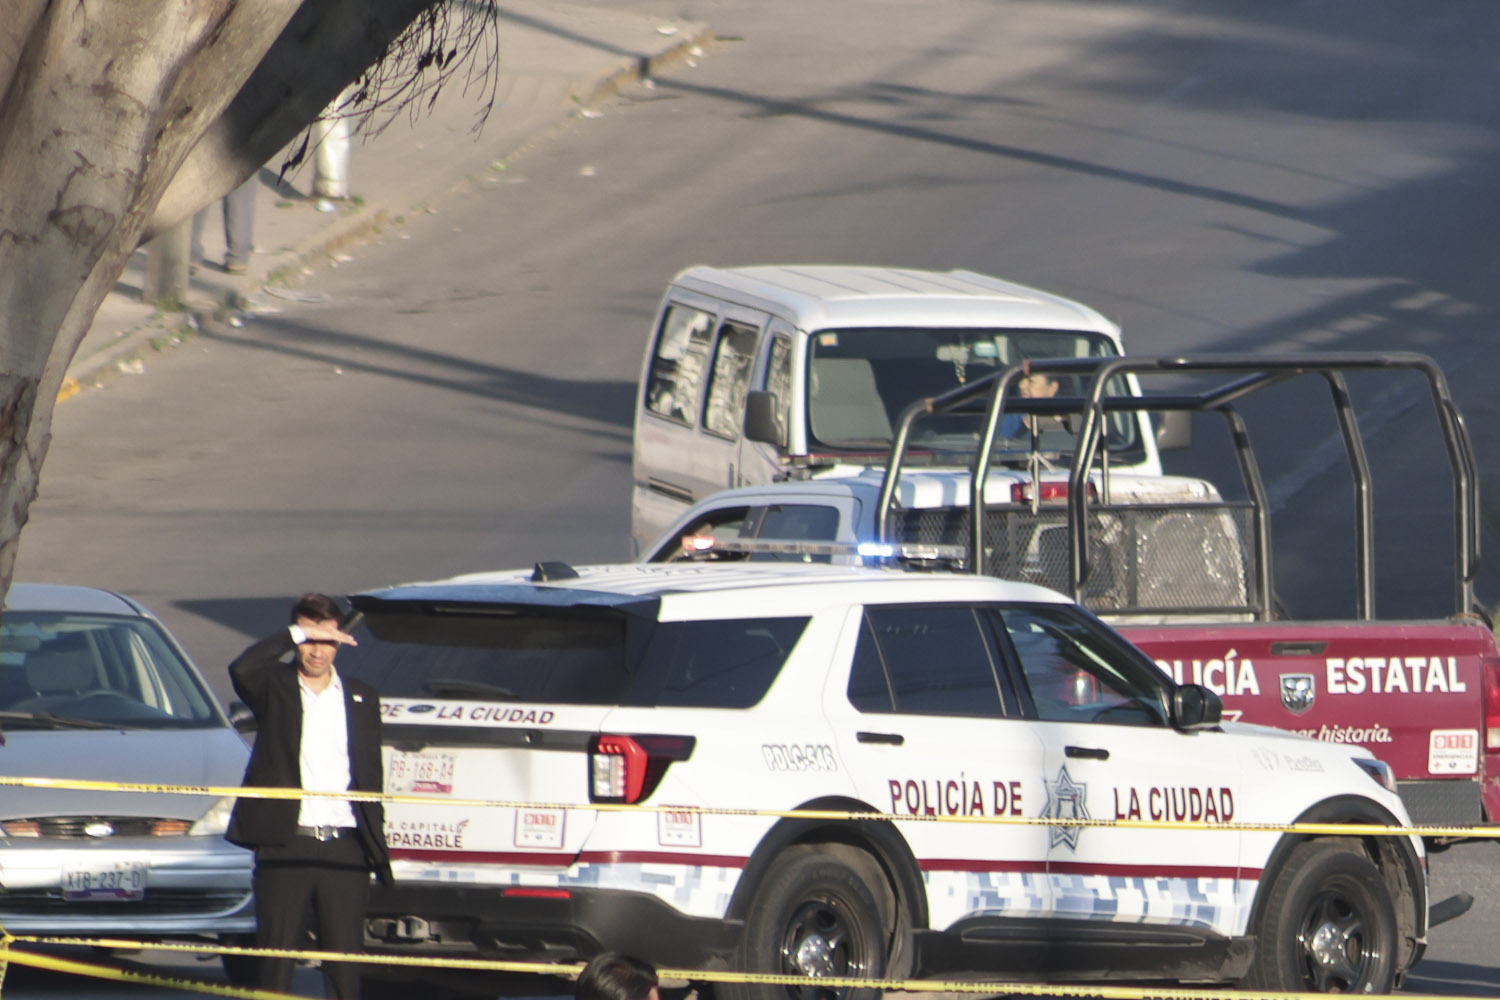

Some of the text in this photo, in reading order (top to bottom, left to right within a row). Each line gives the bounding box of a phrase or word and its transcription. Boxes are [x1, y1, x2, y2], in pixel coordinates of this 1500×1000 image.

[1154, 649, 1467, 695] LICÍA ESTATAL
[437, 706, 464, 720] LA
[469, 707, 556, 725] CIUDAD
[1318, 724, 1392, 743] historia.
[1434, 735, 1473, 749] 911
[888, 772, 1235, 823] POLICÍA DE LA CIUDAD
[386, 833, 463, 848] MPARABLE
